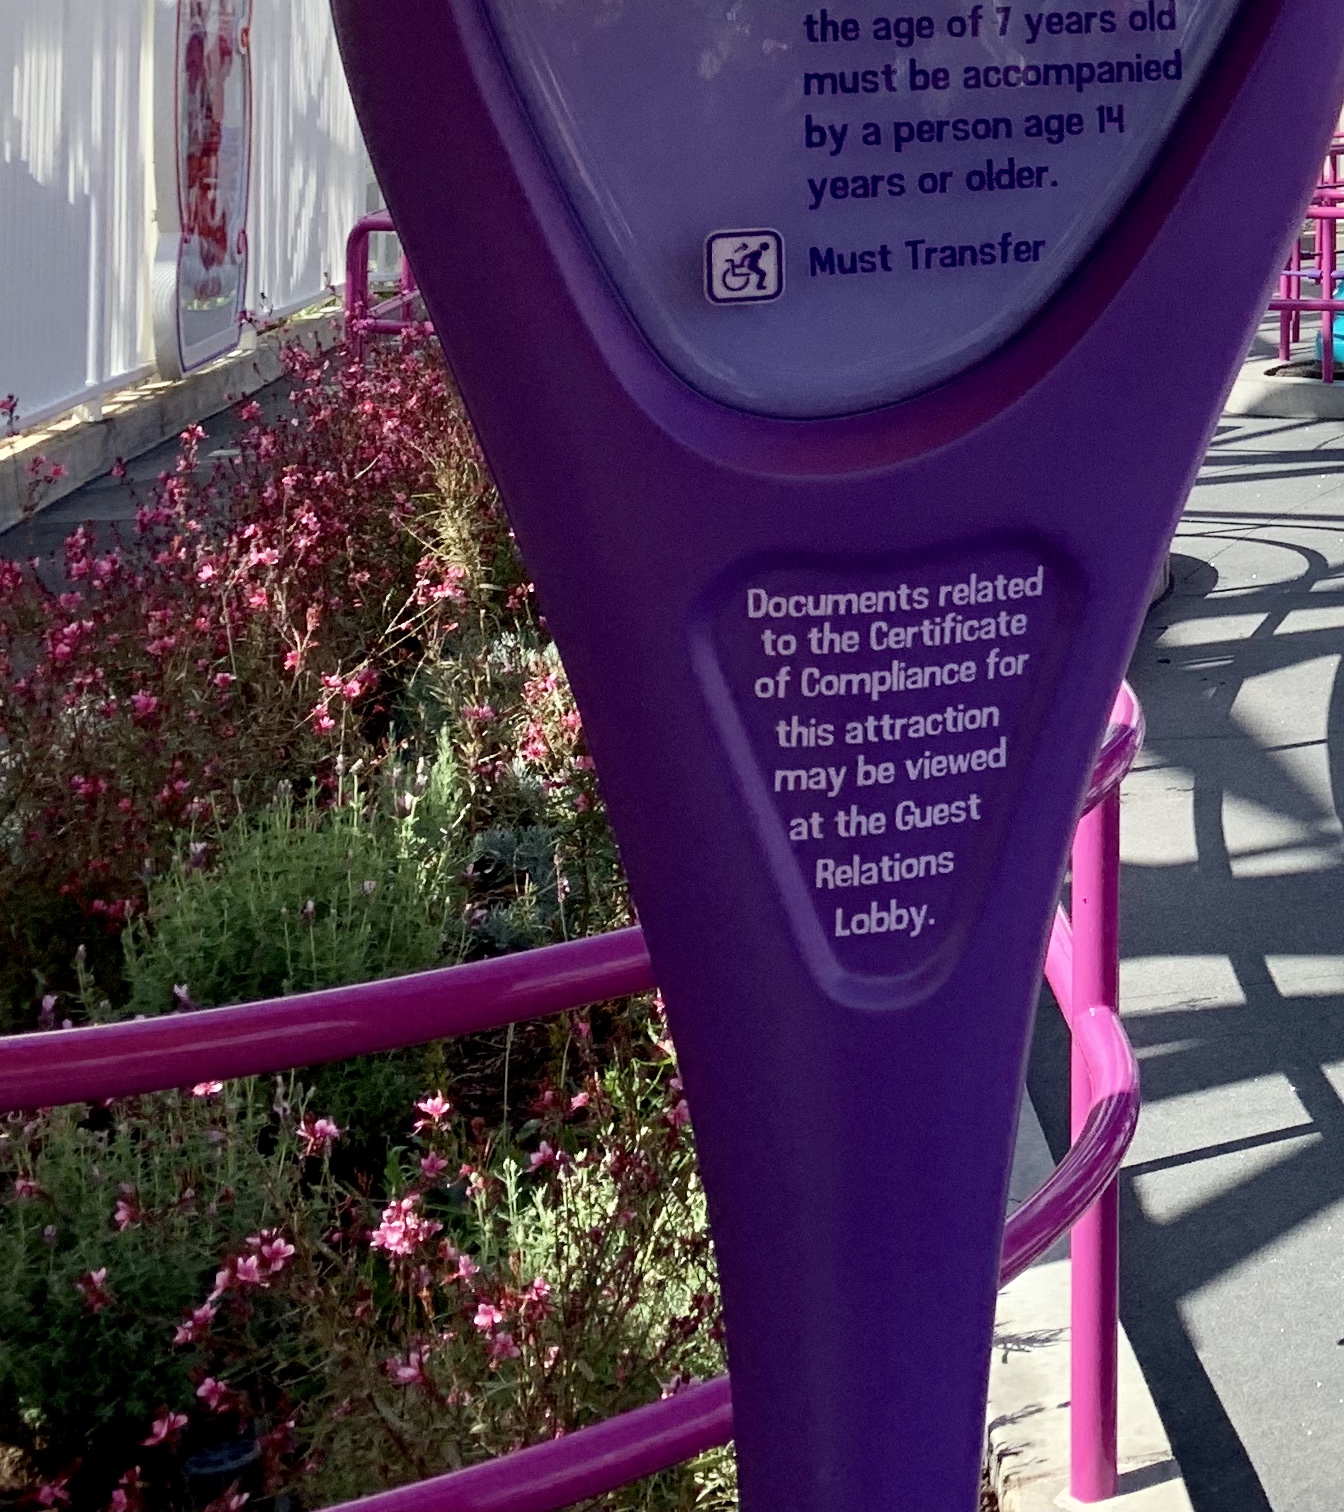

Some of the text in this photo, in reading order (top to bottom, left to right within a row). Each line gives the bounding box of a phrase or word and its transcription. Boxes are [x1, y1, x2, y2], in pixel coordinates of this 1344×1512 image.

[804, 0, 1176, 48] the age of 7 years old
[804, 49, 1182, 96] must be accompanied
[805, 104, 1124, 155] by a person age 14
[807, 159, 1059, 210] years or older.
[810, 232, 1045, 277] Must Transfer
[747, 565, 1044, 618] Documents related
[761, 612, 1027, 656] to the Certificate
[754, 648, 1029, 701] of Compliance for
[776, 704, 1000, 748] this attraction
[774, 736, 1007, 798] may be viewed
[789, 793, 981, 841] at the Guest
[816, 850, 955, 890] Relations
[835, 899, 935, 938] Lobby.
